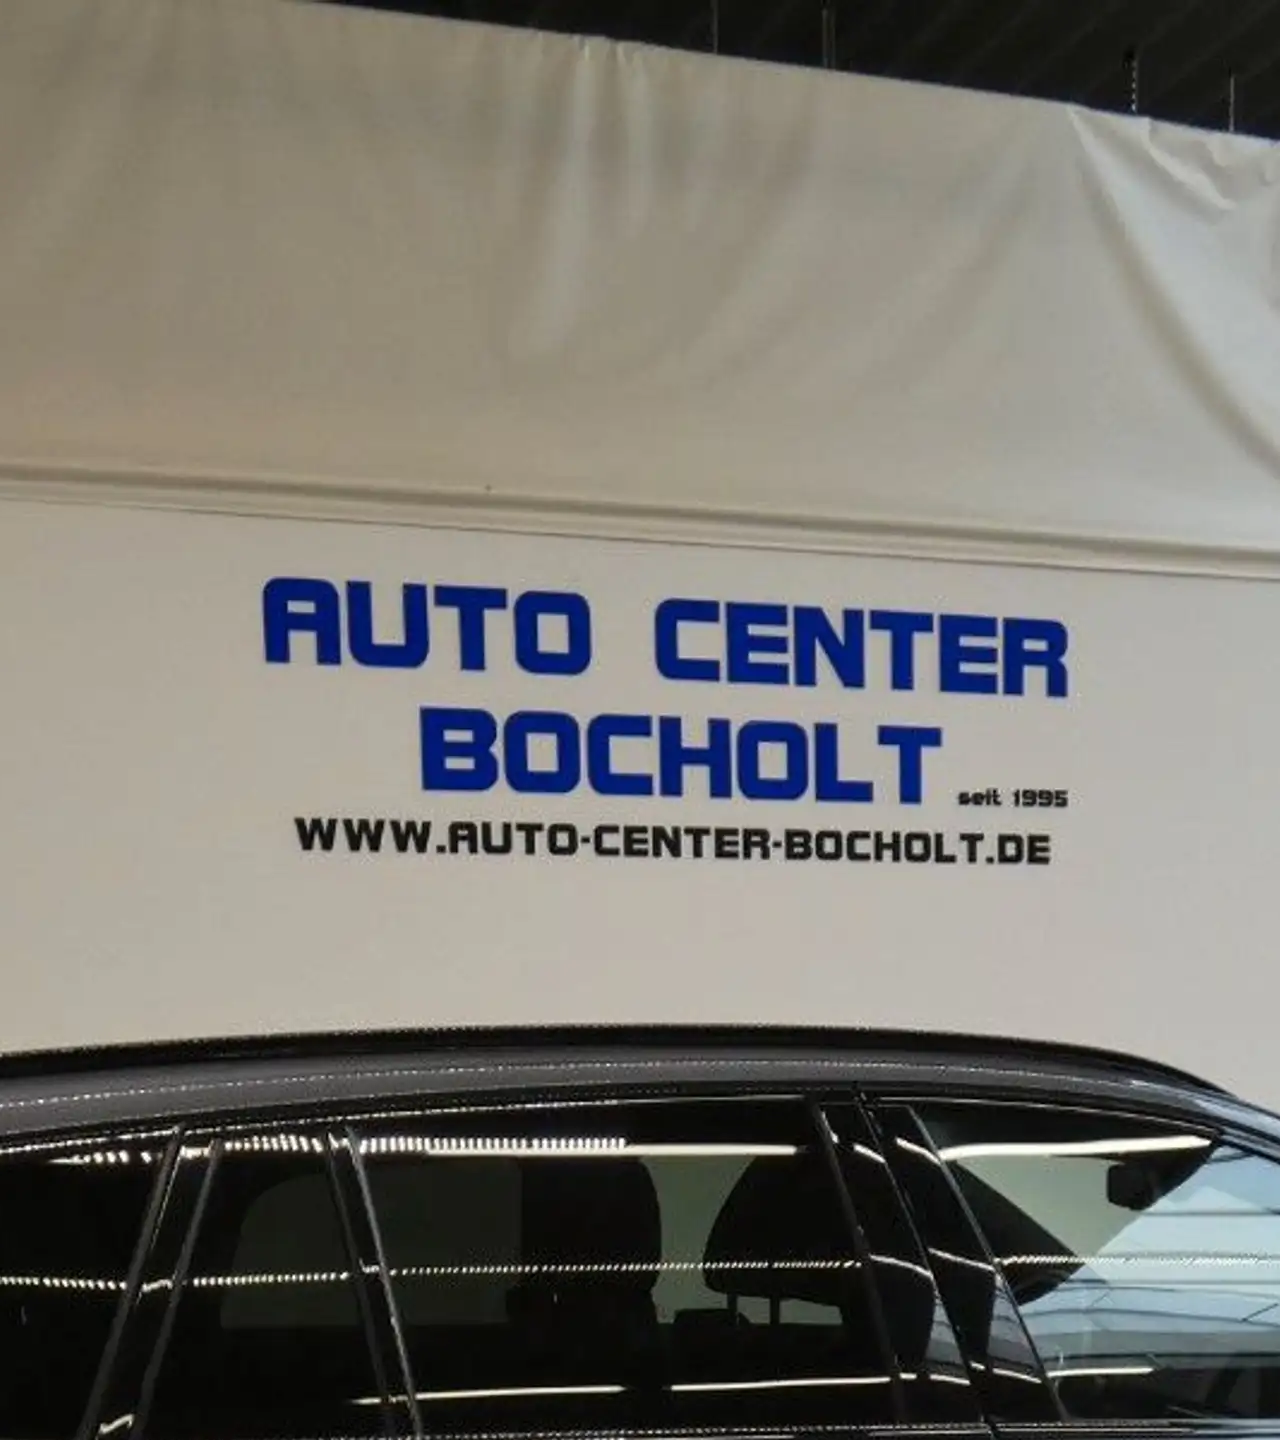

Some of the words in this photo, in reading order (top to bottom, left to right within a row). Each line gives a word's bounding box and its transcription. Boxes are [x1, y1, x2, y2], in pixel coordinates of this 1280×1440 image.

[263, 577, 592, 676] AUTO
[654, 598, 1069, 698] CENTER
[419, 707, 943, 806] BOCHOLT
[958, 788, 1003, 807] seit
[1013, 788, 1069, 808] 1995
[293, 816, 1052, 867] WWW.AUTO-CENTER-BOCHOLT.DE
